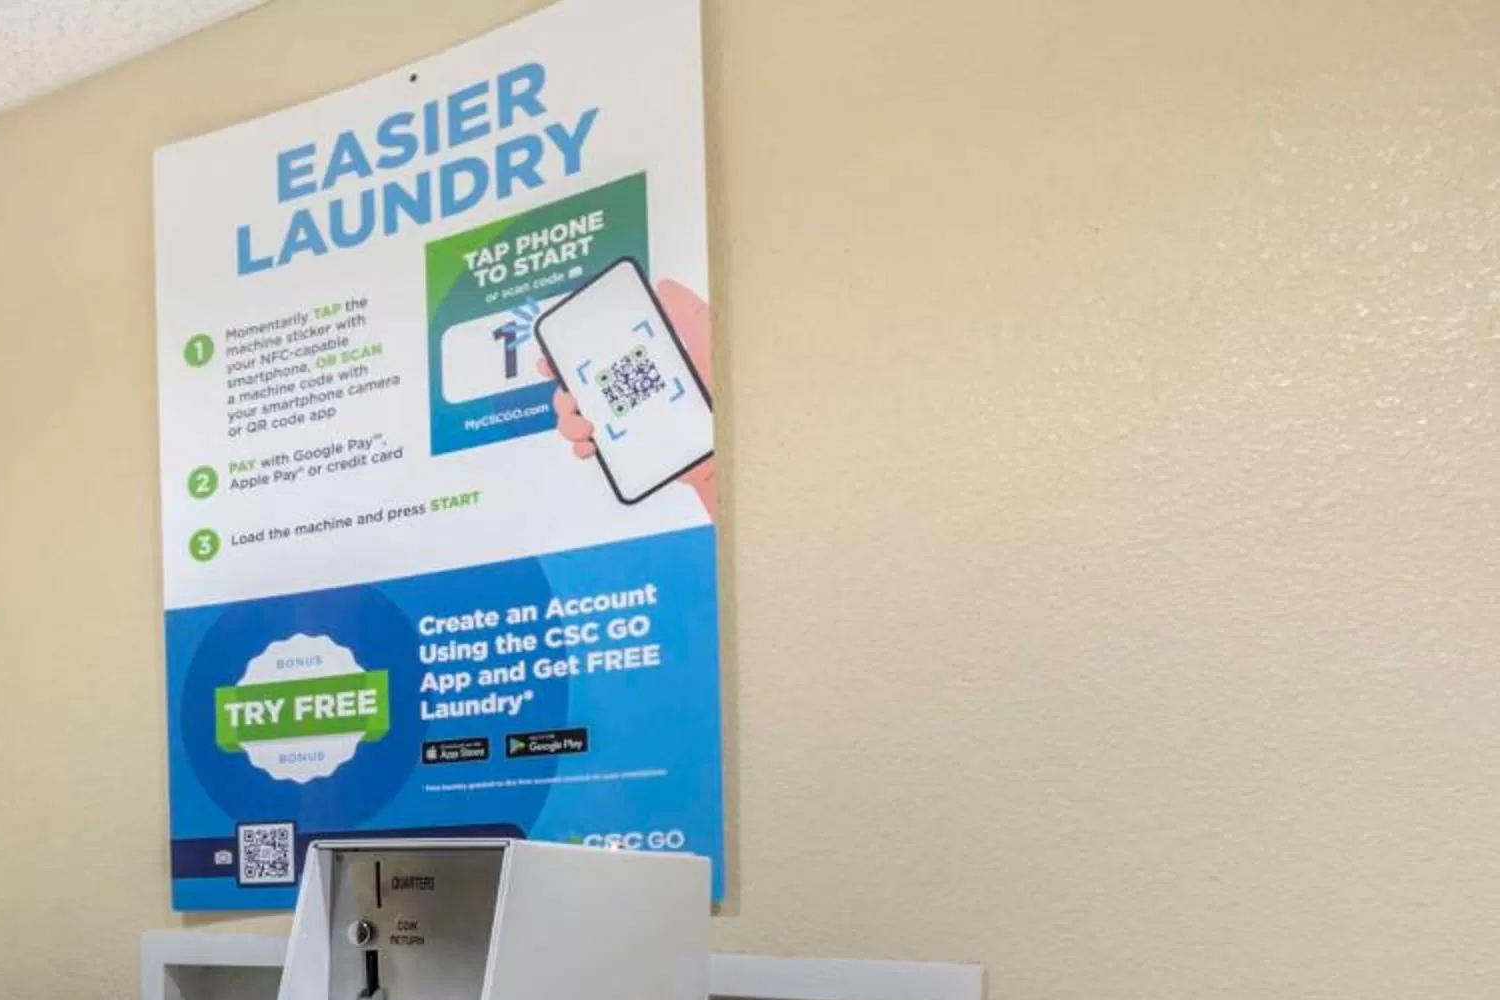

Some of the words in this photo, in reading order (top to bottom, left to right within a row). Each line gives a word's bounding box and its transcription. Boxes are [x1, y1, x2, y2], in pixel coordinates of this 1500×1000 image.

[277, 62, 547, 203] EASIER
[236, 107, 600, 276] LAUNDRY
[463, 242, 509, 271] TAP
[516, 210, 605, 255] PHONE
[475, 265, 506, 288] TO
[514, 236, 594, 277] START
[486, 292, 498, 303] or
[502, 283, 530, 299] scan
[533, 273, 564, 290] code
[225, 311, 309, 341] Momentarily
[313, 303, 341, 320] TAP
[345, 297, 368, 312] the
[225, 335, 283, 356] machine
[286, 325, 332, 344] sticker
[336, 313, 366, 331] with
[226, 358, 256, 375] your
[260, 336, 349, 366] NFC-capable
[227, 362, 311, 389] smartphone,
[315, 355, 336, 370] OR
[341, 343, 383, 364] SCAN
[228, 394, 235, 405] a
[239, 382, 296, 402] machine
[299, 372, 333, 390] code
[338, 364, 369, 381] with
[228, 406, 257, 424] your
[262, 387, 345, 415] smartphone
[348, 374, 400, 396] camera
[228, 426, 241, 437] or
[246, 420, 267, 435] QR
[271, 412, 305, 430] code
[310, 407, 336, 421] app
[229, 459, 257, 475] PAY
[260, 453, 289, 469] with
[293, 443, 343, 464] Google
[229, 475, 270, 491] Apple
[307, 464, 322, 476] or
[326, 455, 367, 473] credit
[371, 448, 403, 465] card
[231, 531, 265, 547] Load
[268, 526, 291, 541] the
[295, 515, 352, 536] machine
[356, 509, 383, 526] and
[387, 502, 426, 521] press
[430, 490, 481, 512] START
[419, 609, 499, 637] Create
[506, 604, 537, 624] an
[546, 583, 657, 619] Account
[419, 640, 488, 664] Using
[495, 632, 537, 655] the
[545, 622, 599, 648] CSC
[607, 615, 651, 640] GO
[276, 655, 322, 670] BONUS
[420, 671, 471, 694] App
[478, 660, 526, 686] and
[533, 654, 580, 679] Get
[587, 644, 660, 673] FREE
[224, 698, 285, 728] TRY
[294, 688, 378, 721] FREE
[278, 751, 325, 764] BONUS
[529, 740, 562, 753] Google
[647, 830, 684, 849] GO
